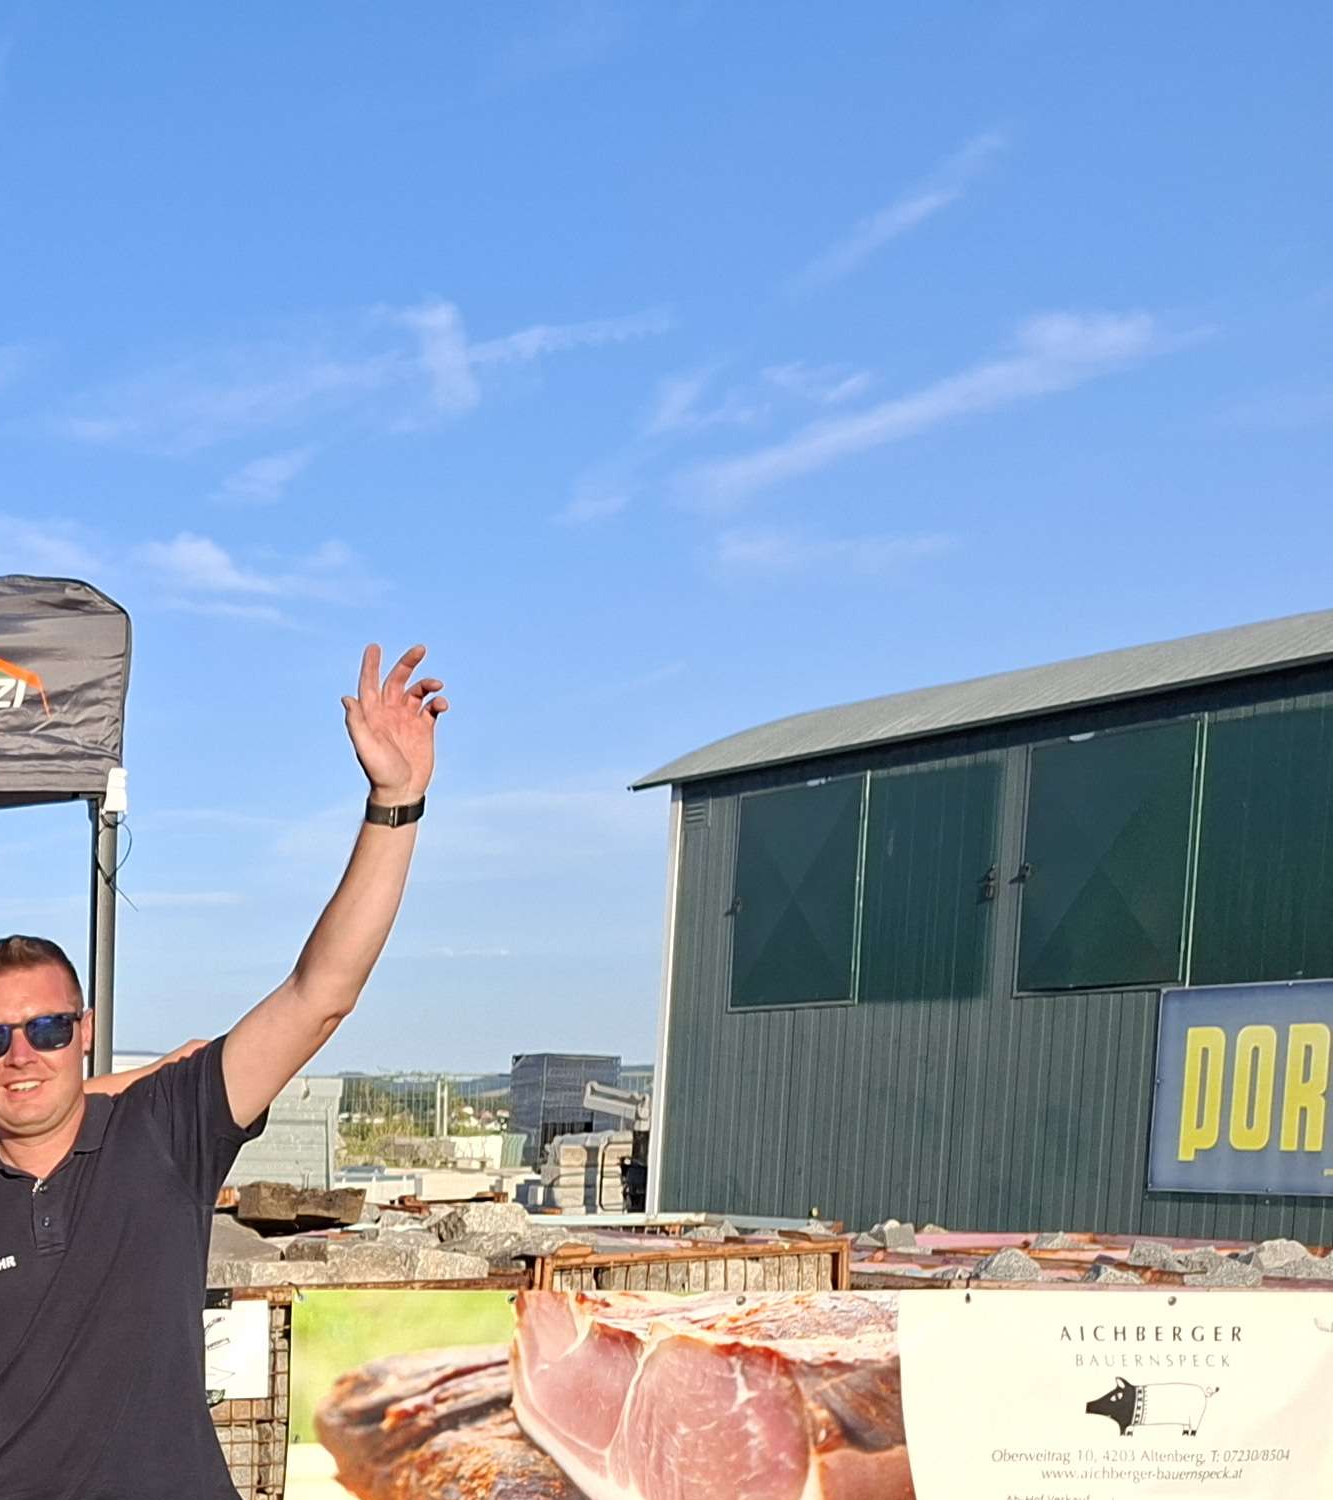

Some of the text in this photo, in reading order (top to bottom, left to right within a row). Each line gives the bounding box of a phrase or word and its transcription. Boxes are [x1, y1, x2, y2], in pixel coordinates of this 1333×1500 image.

[1060, 1326, 1243, 1342] AICHBERGER
[1075, 1353, 1231, 1368] BAUERNSPECK
[1041, 1466, 1243, 1484] www.aichberger-bauernspeck.at
